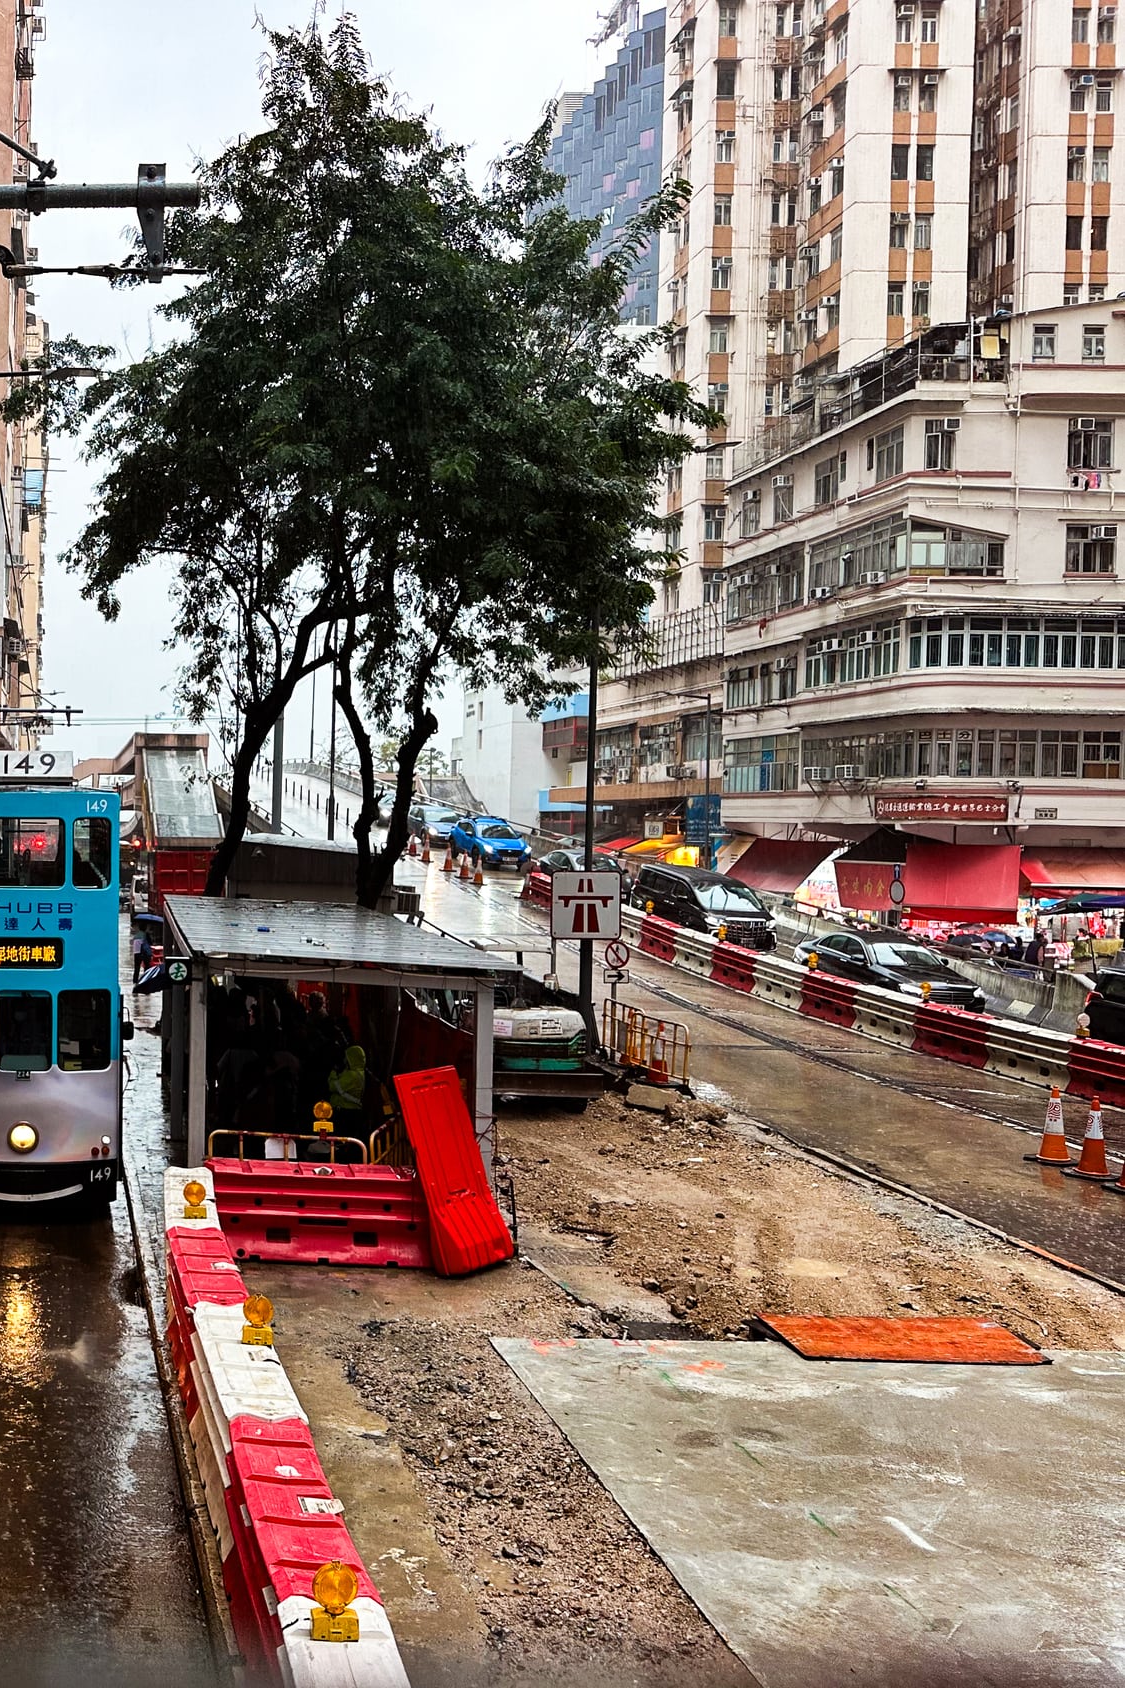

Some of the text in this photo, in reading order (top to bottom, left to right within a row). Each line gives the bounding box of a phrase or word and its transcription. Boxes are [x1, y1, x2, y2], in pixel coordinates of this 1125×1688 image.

[4, 753, 56, 775] 149
[86, 799, 108, 813] 149
[90, 1166, 111, 1183] 149
